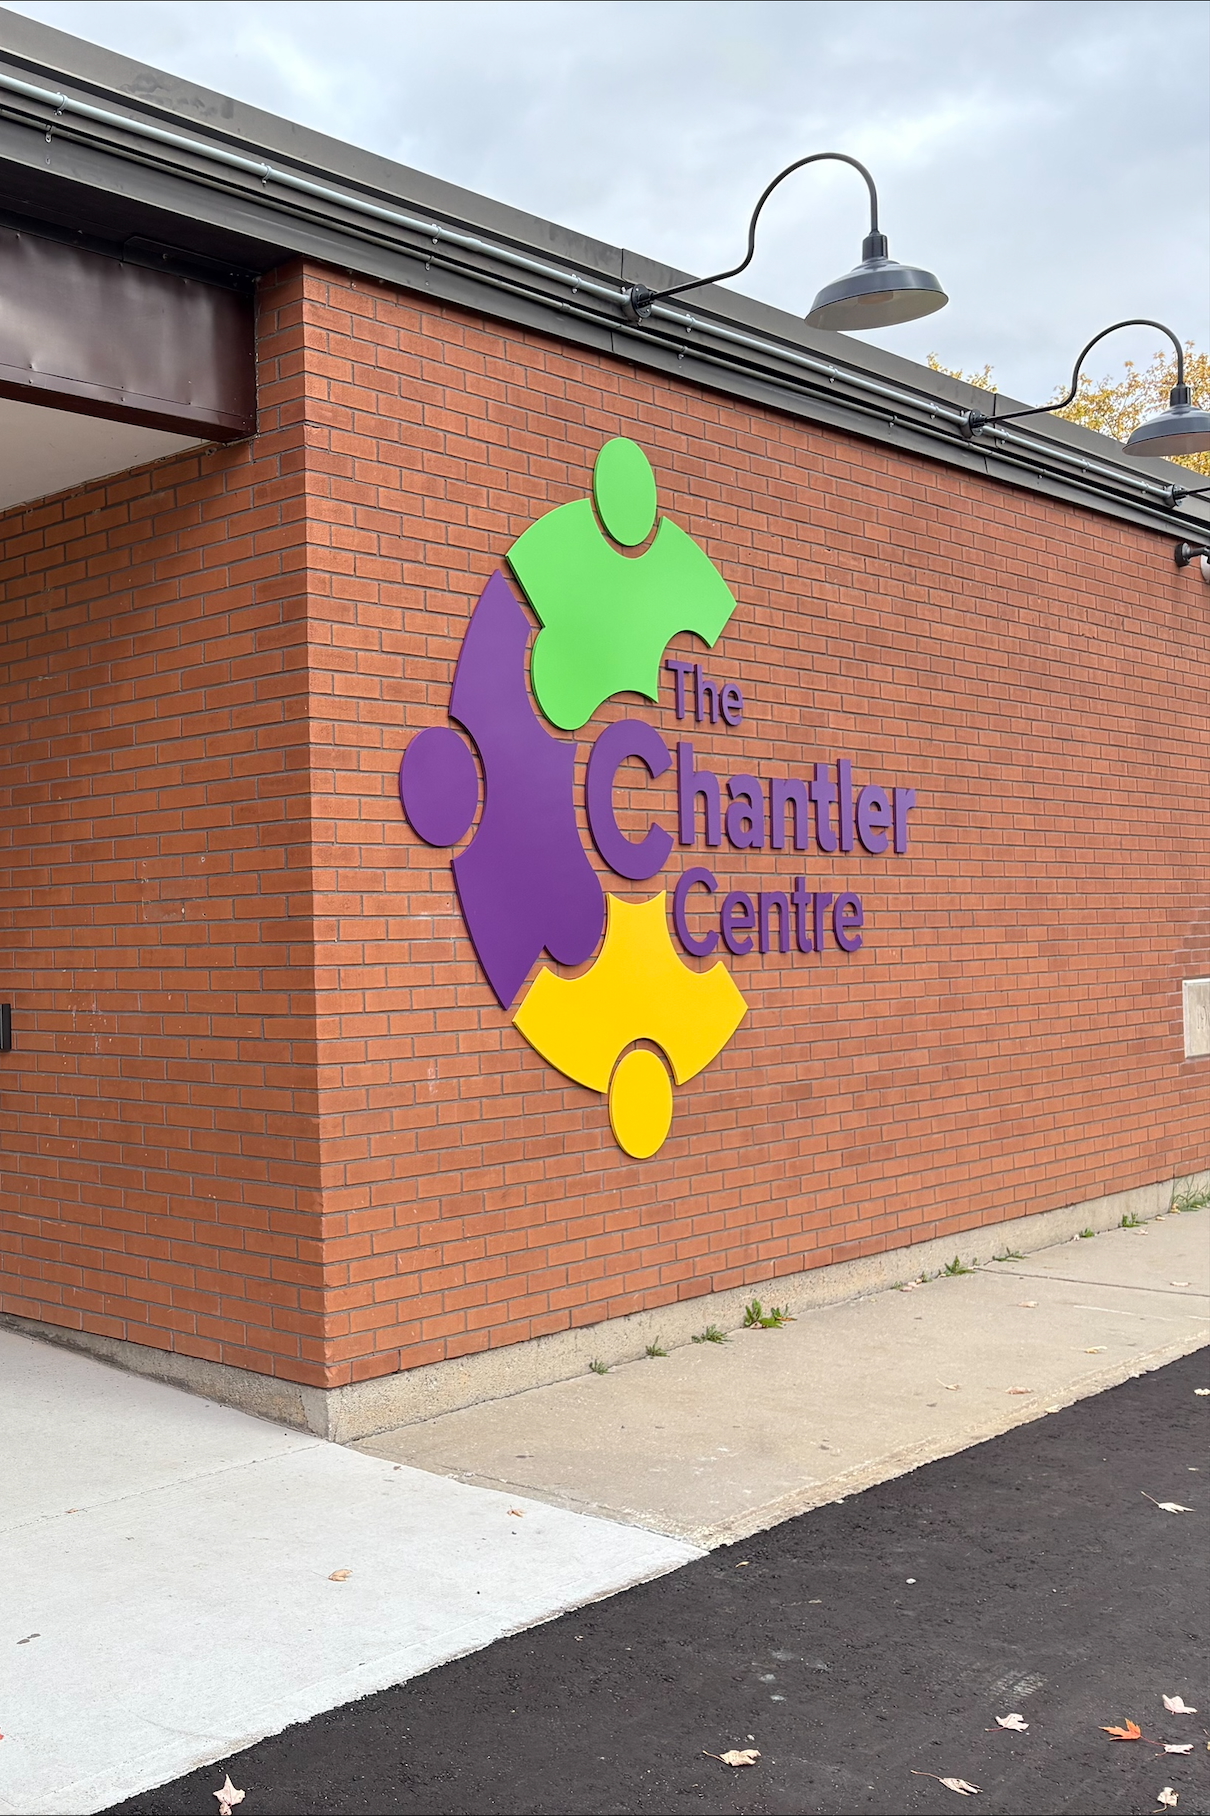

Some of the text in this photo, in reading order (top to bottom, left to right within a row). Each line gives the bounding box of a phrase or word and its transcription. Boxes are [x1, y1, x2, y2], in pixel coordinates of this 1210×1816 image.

[665, 659, 744, 726] The
[585, 719, 916, 880] Chantler
[673, 866, 864, 957] Centre
[1197, 1005, 1210, 1030] 19
